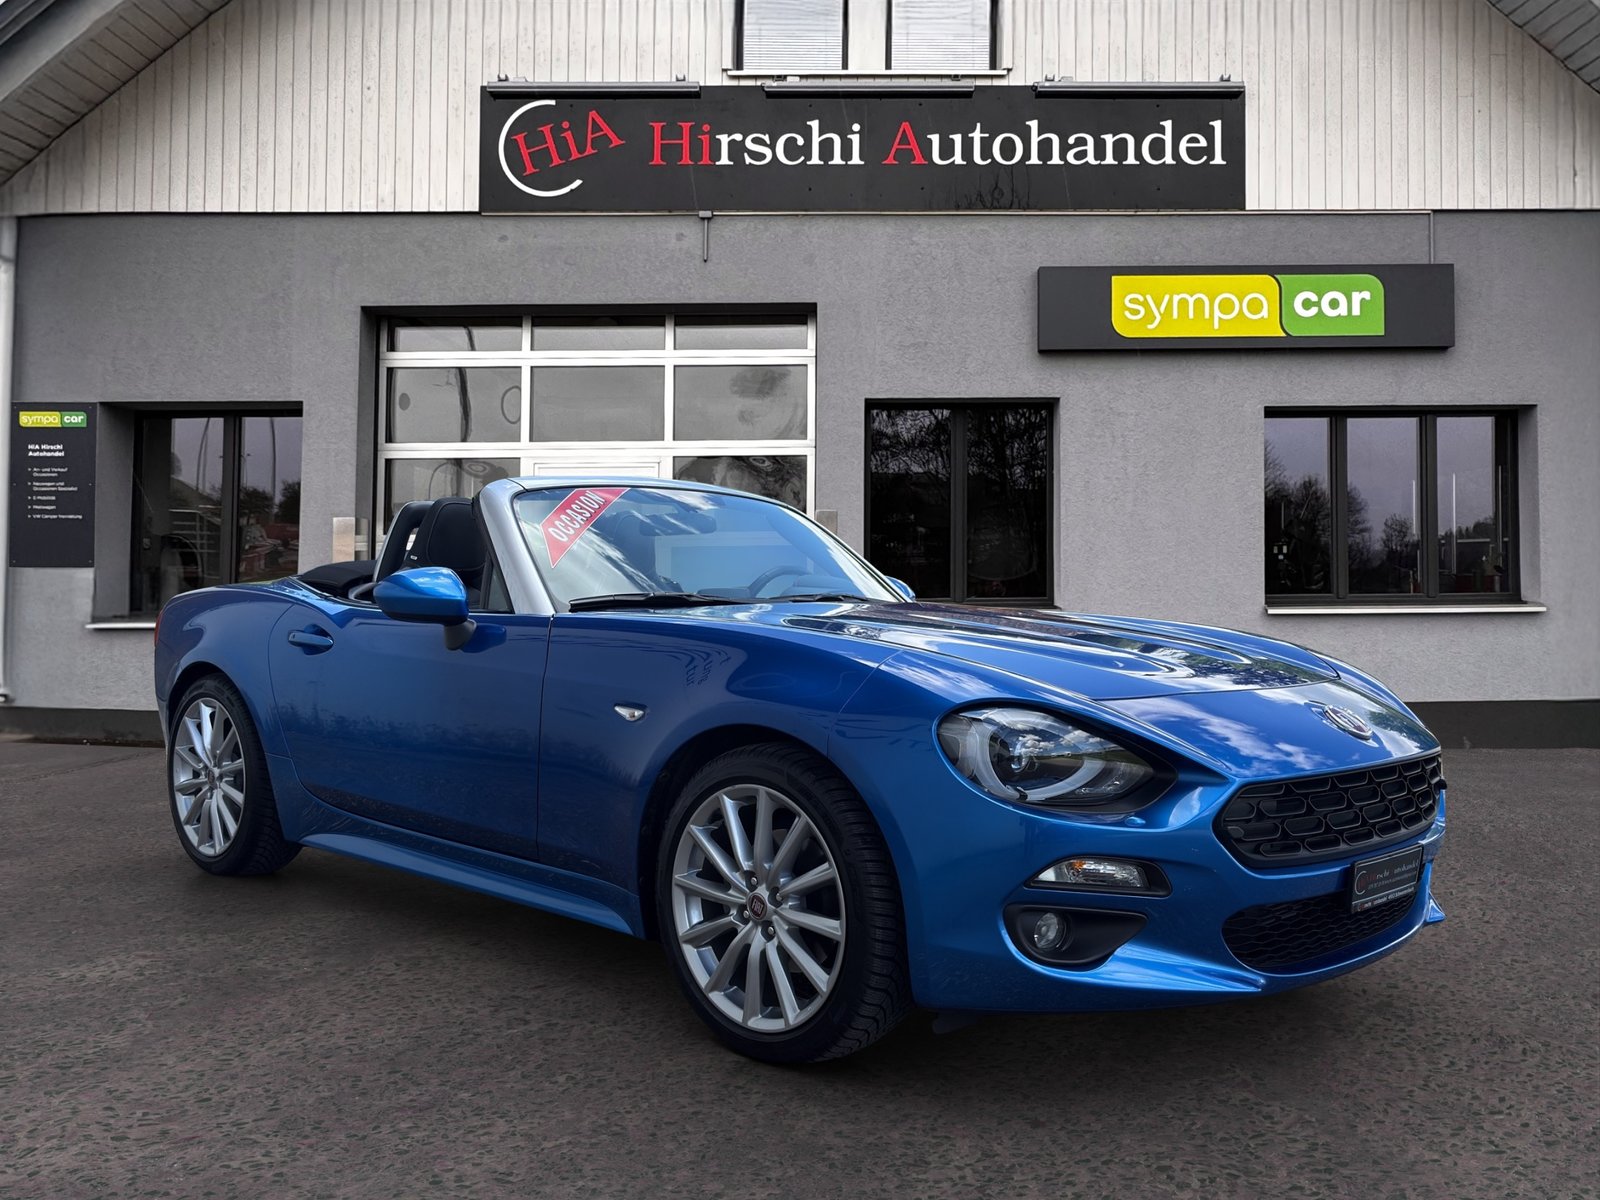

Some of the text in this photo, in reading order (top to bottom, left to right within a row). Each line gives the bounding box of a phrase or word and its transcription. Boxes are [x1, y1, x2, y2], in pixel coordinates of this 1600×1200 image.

[510, 109, 626, 176] HiA
[648, 119, 1227, 166] Hirschi Autohandel
[1123, 290, 1371, 330] sympa car
[21, 415, 84, 425] sympa car
[548, 490, 605, 542] OCCASION
